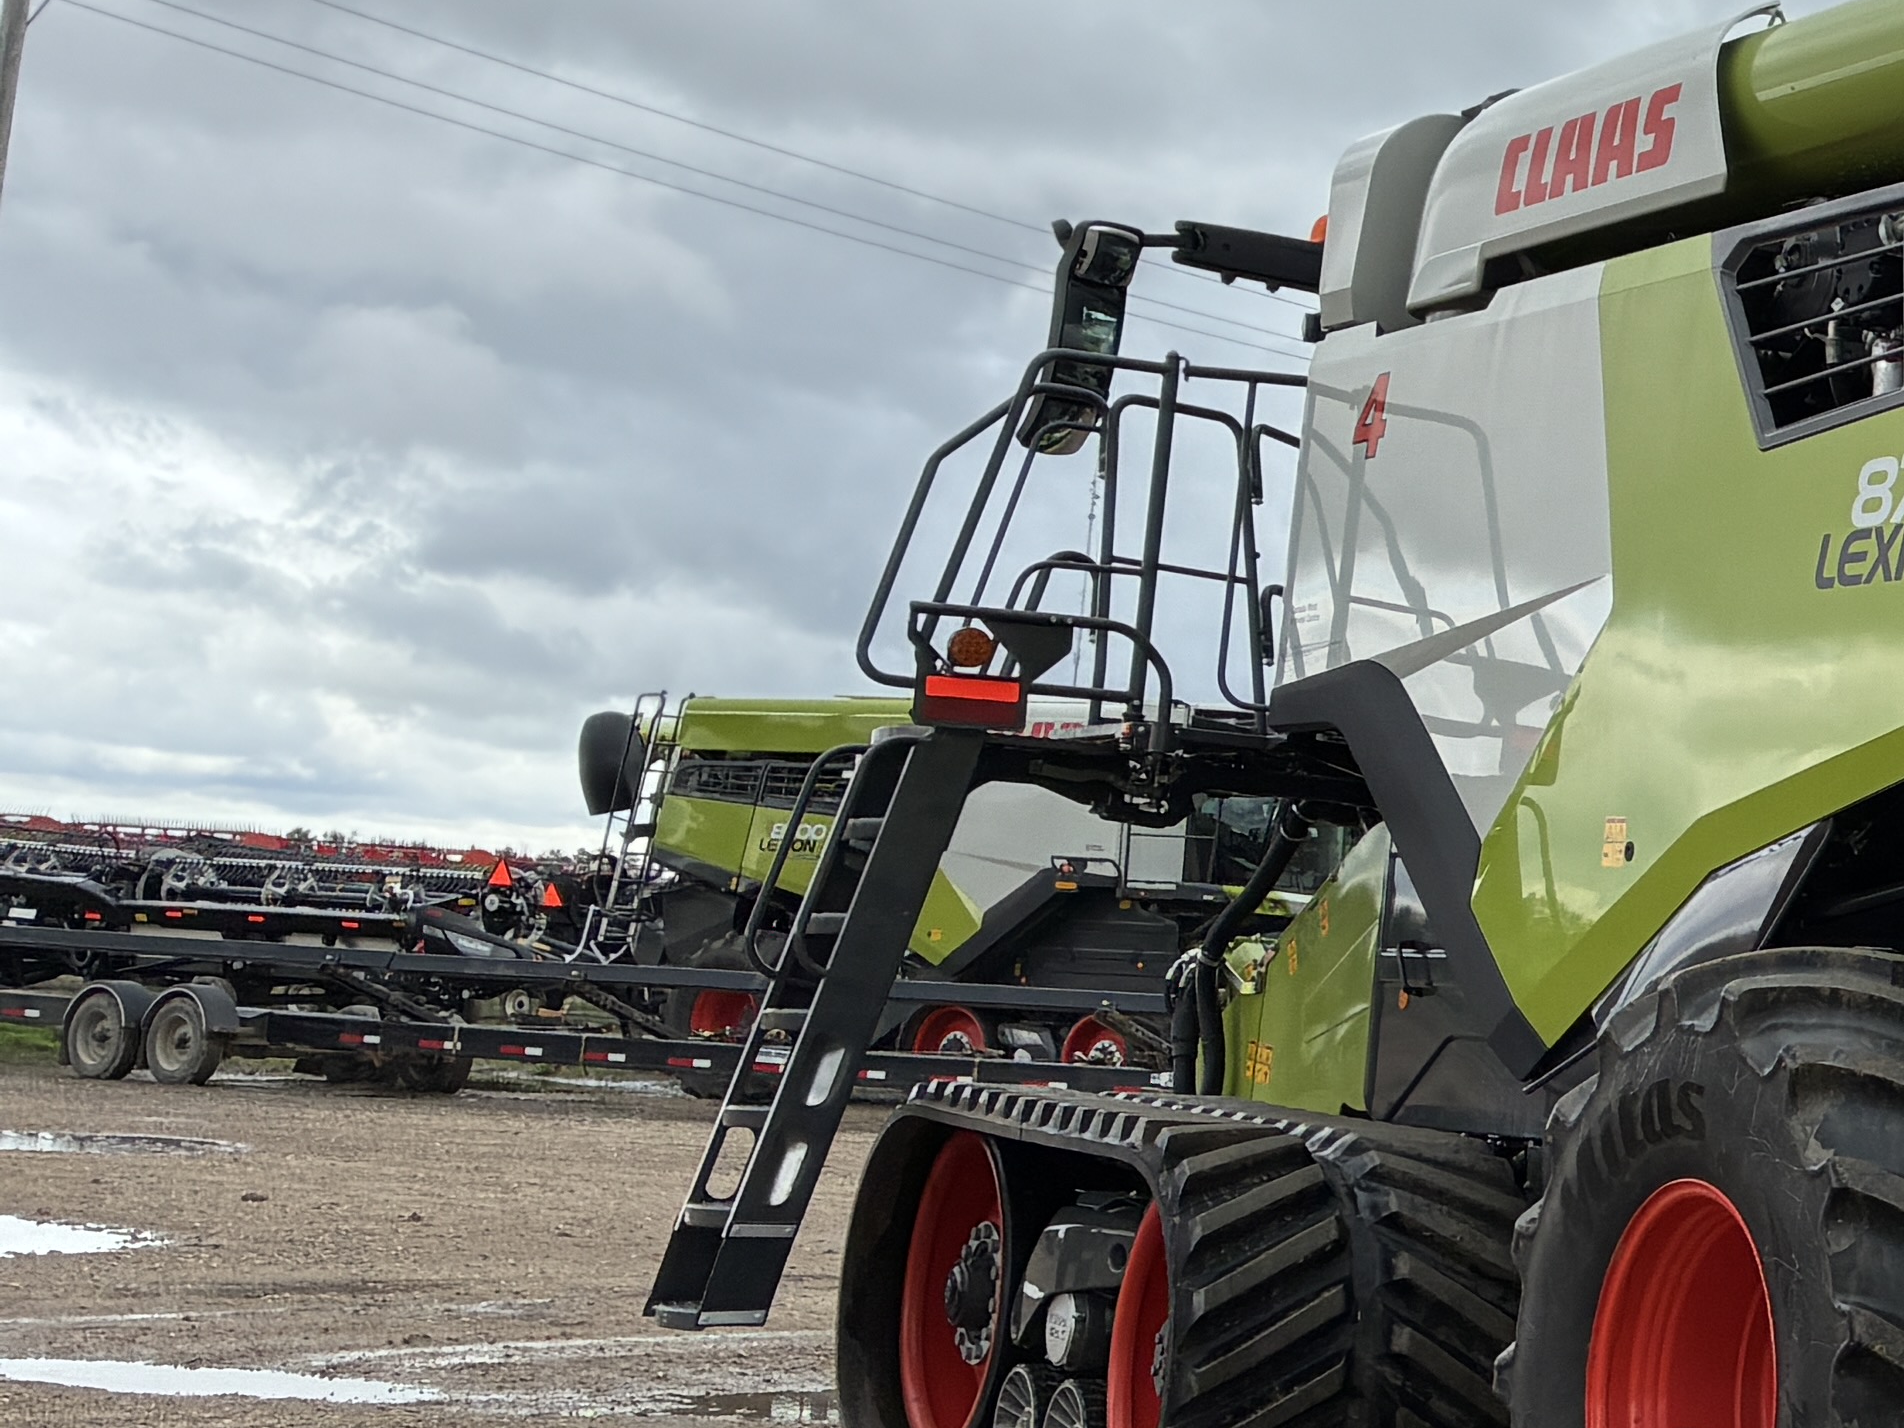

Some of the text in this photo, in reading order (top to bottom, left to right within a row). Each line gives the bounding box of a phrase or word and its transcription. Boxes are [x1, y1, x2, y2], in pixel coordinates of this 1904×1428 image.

[1494, 82, 1683, 216] CLAAS
[1352, 371, 1391, 460] 4
[759, 837, 817, 853] LEON
[771, 823, 827, 840] 800
